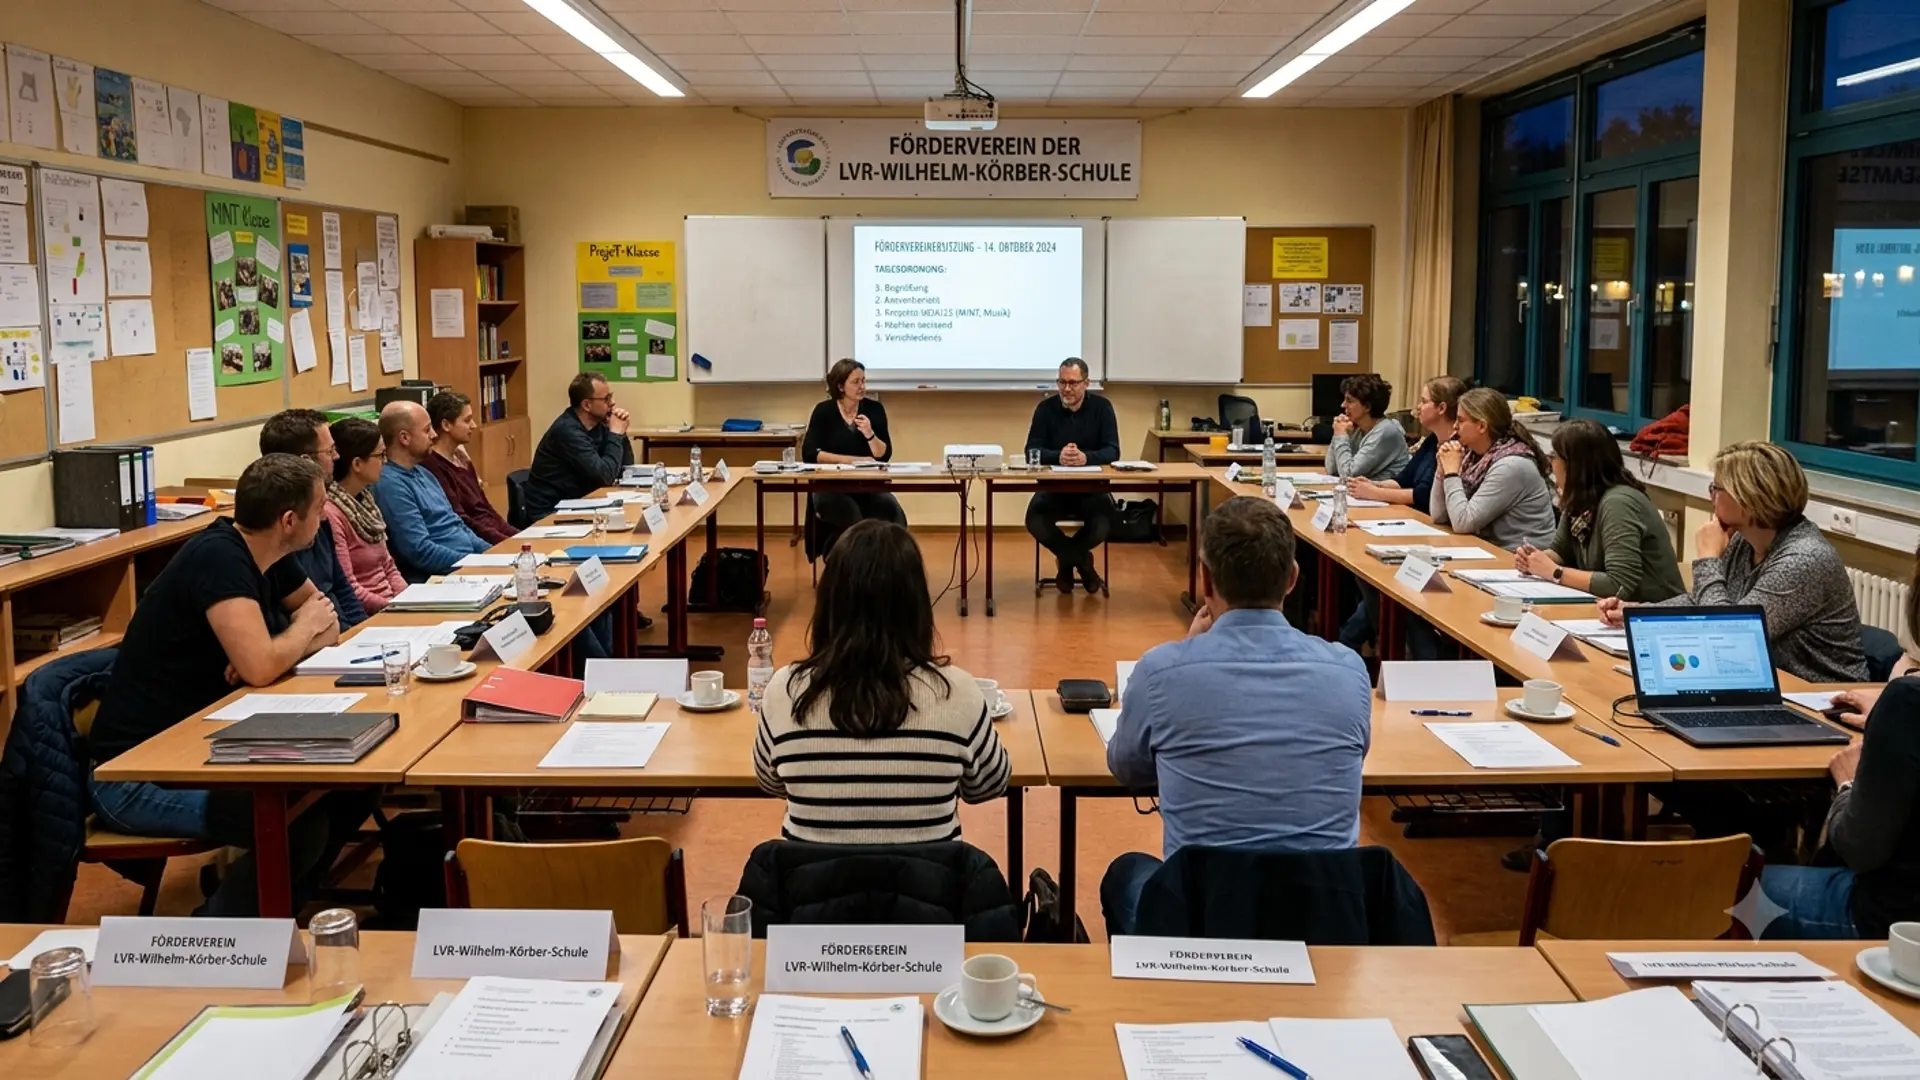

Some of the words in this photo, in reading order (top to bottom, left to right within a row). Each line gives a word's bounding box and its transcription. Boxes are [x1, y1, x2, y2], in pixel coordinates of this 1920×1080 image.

[889, 132, 1037, 156] FÖRDERVEREIN
[1046, 136, 1081, 156] DER
[838, 160, 1132, 183] LVR-WILHELM-KÖRBER-SCHULE
[984, 242, 996, 253] 14.
[1036, 242, 1057, 253] 2024
